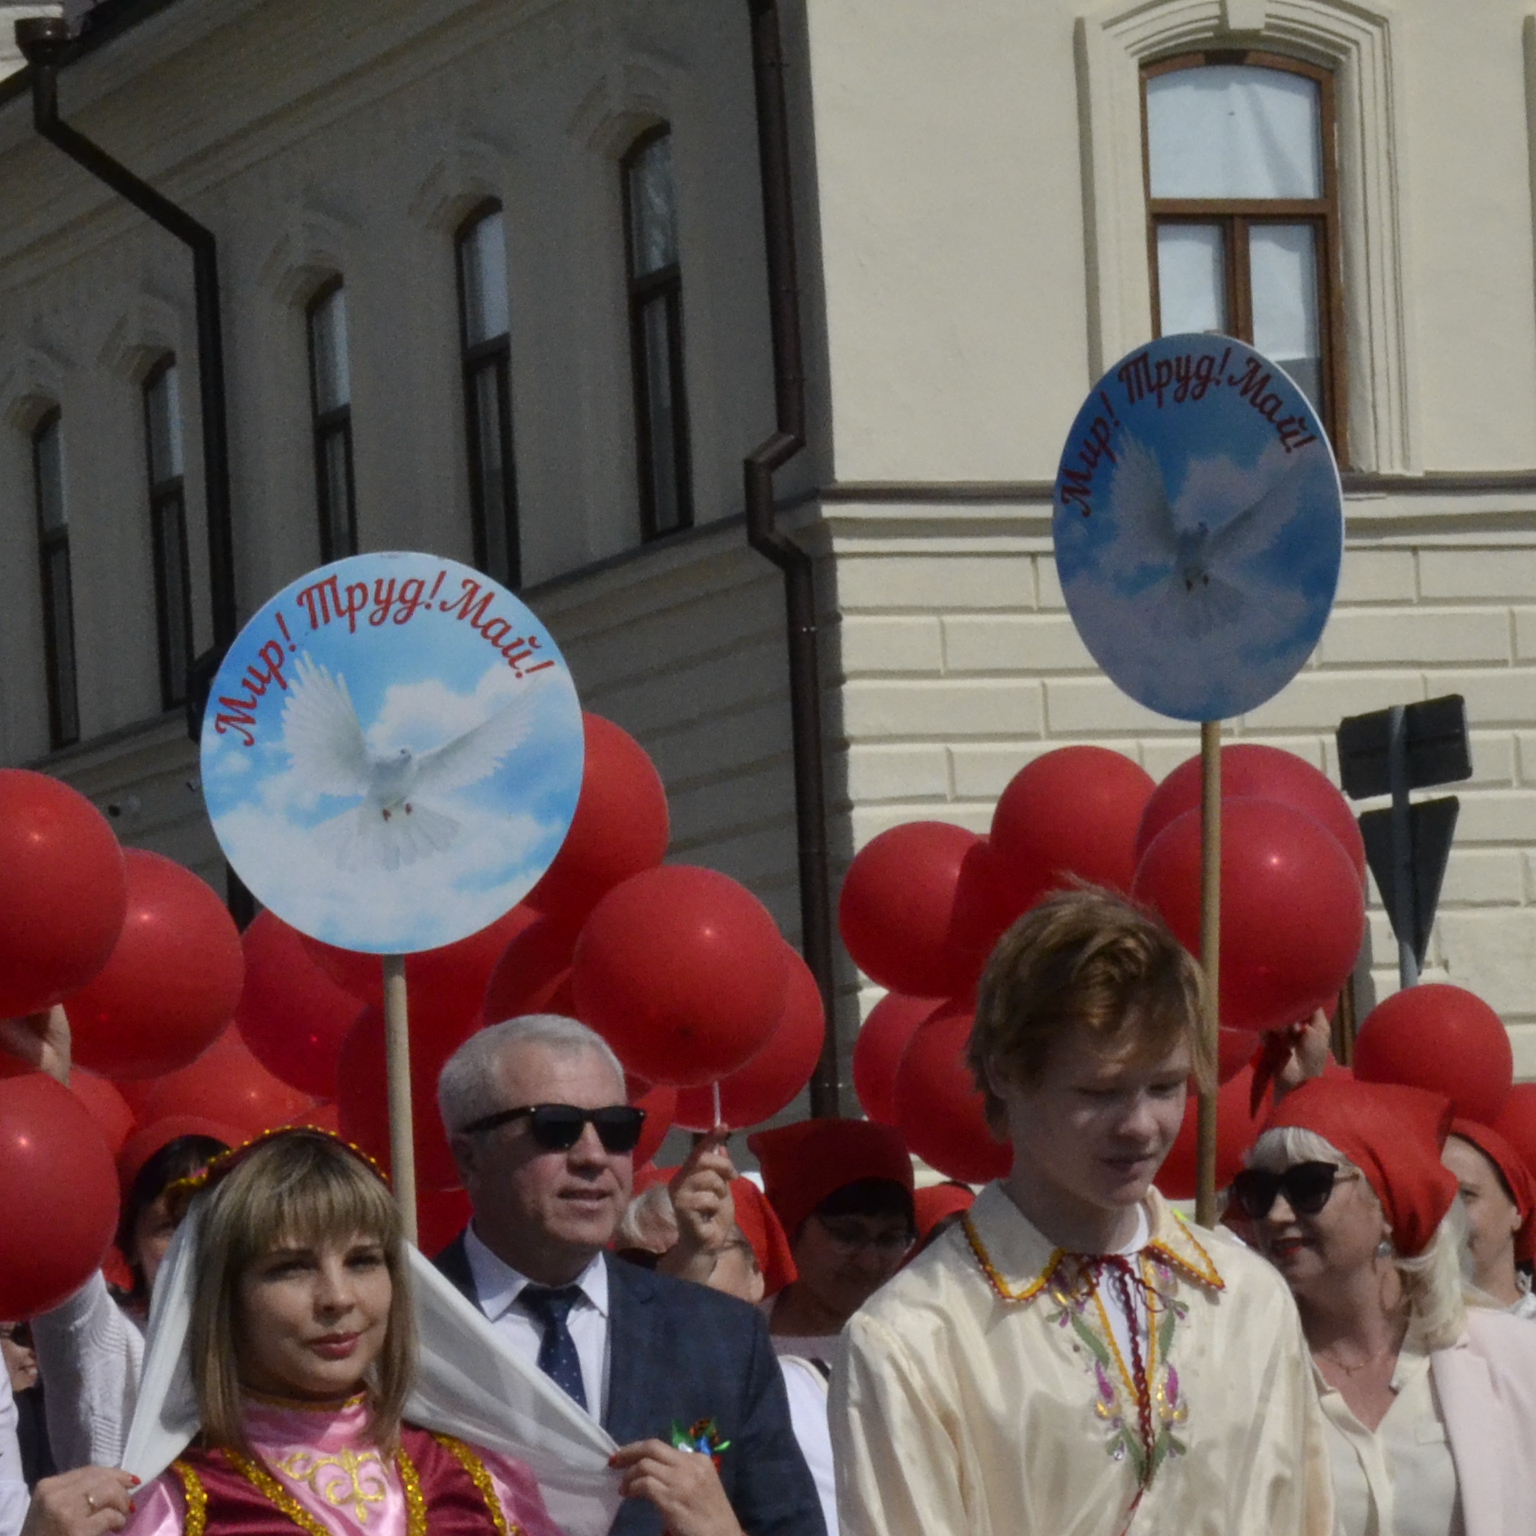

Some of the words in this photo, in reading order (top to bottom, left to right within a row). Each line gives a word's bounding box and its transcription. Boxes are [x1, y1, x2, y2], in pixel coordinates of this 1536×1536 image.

[1061, 391, 1120, 518] Мир!
[1118, 347, 1232, 409] Труд!
[1227, 356, 1317, 453] Май!
[215, 612, 297, 747] Мир!
[296, 570, 447, 634] Труд!
[439, 578, 555, 679] Май!
